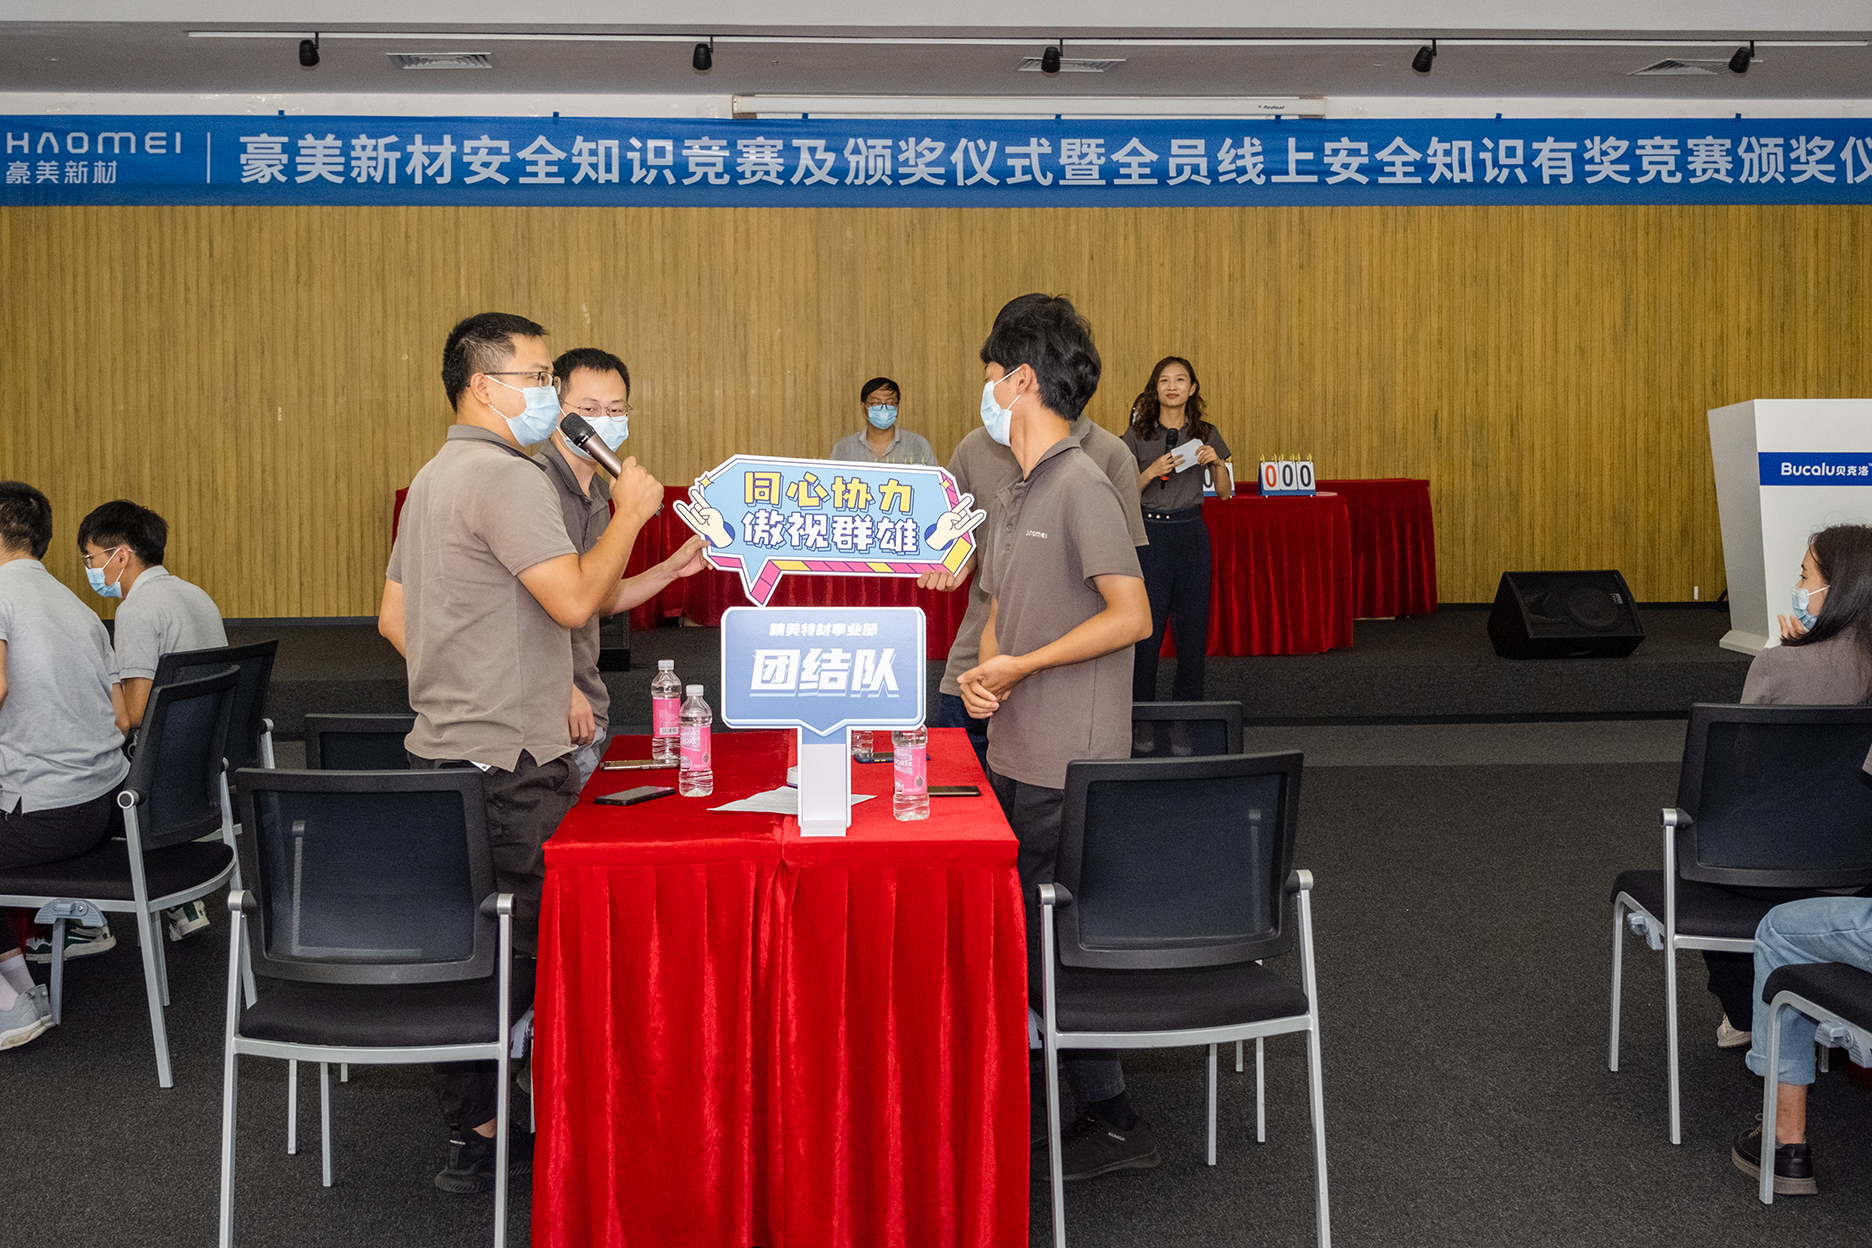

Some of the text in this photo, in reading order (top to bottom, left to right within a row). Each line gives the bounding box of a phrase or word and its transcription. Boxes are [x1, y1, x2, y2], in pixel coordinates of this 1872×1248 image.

[6, 131, 182, 154] HAOMEI
[239, 133, 1872, 186] 豪美新材安全知识竞赛及颁奖仪式暨全员线上安全知识有奖竞赛颁奖仪
[5, 160, 118, 184] 豪美新材
[744, 471, 915, 514] 同心协力
[742, 509, 920, 554] 傲视群雄
[750, 648, 899, 697] 团结队
